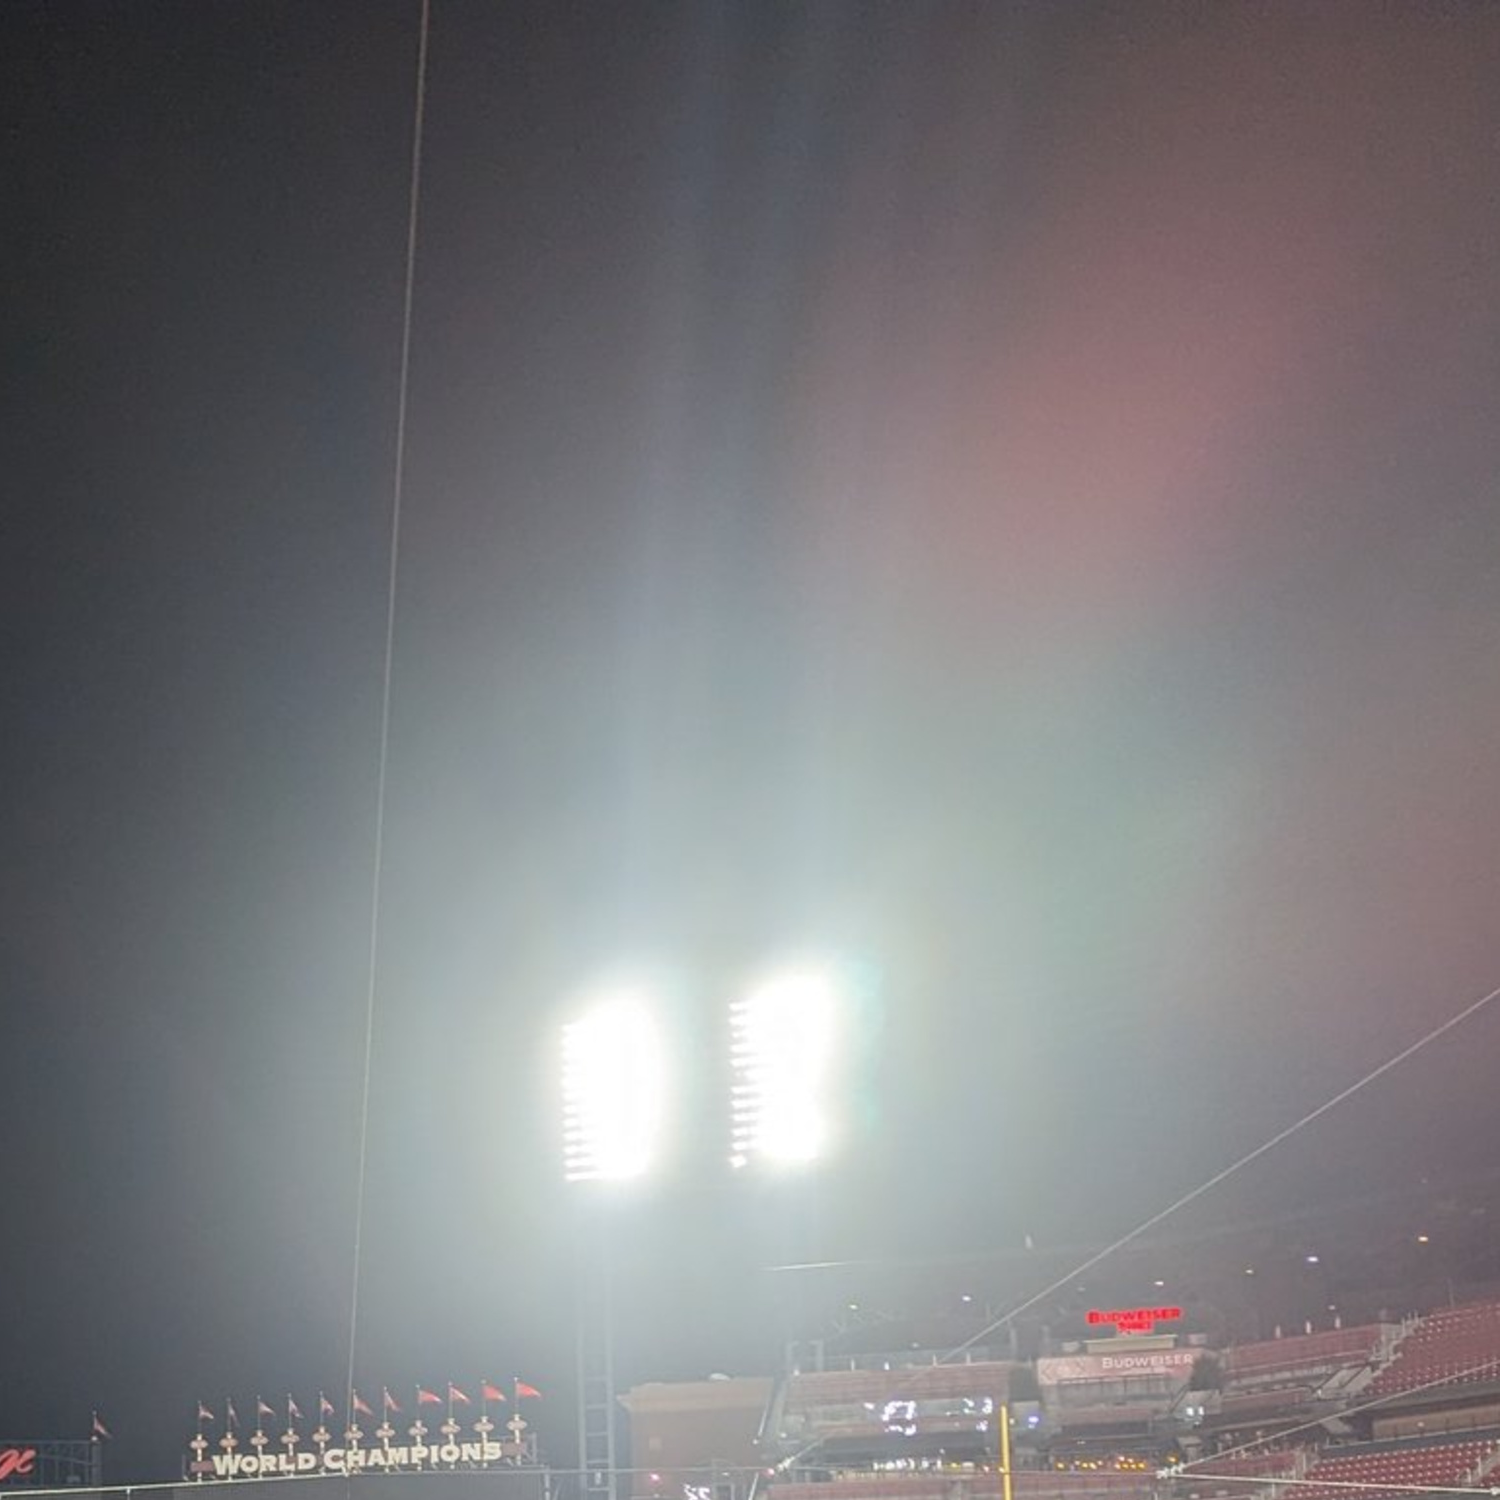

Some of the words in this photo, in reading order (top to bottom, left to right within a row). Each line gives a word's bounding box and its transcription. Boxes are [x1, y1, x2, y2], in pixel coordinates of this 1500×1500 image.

[1102, 1354, 1194, 1369] BUDWEISER
[212, 1453, 317, 1475] WORLD
[323, 1442, 502, 1469] CHAMPIONS
